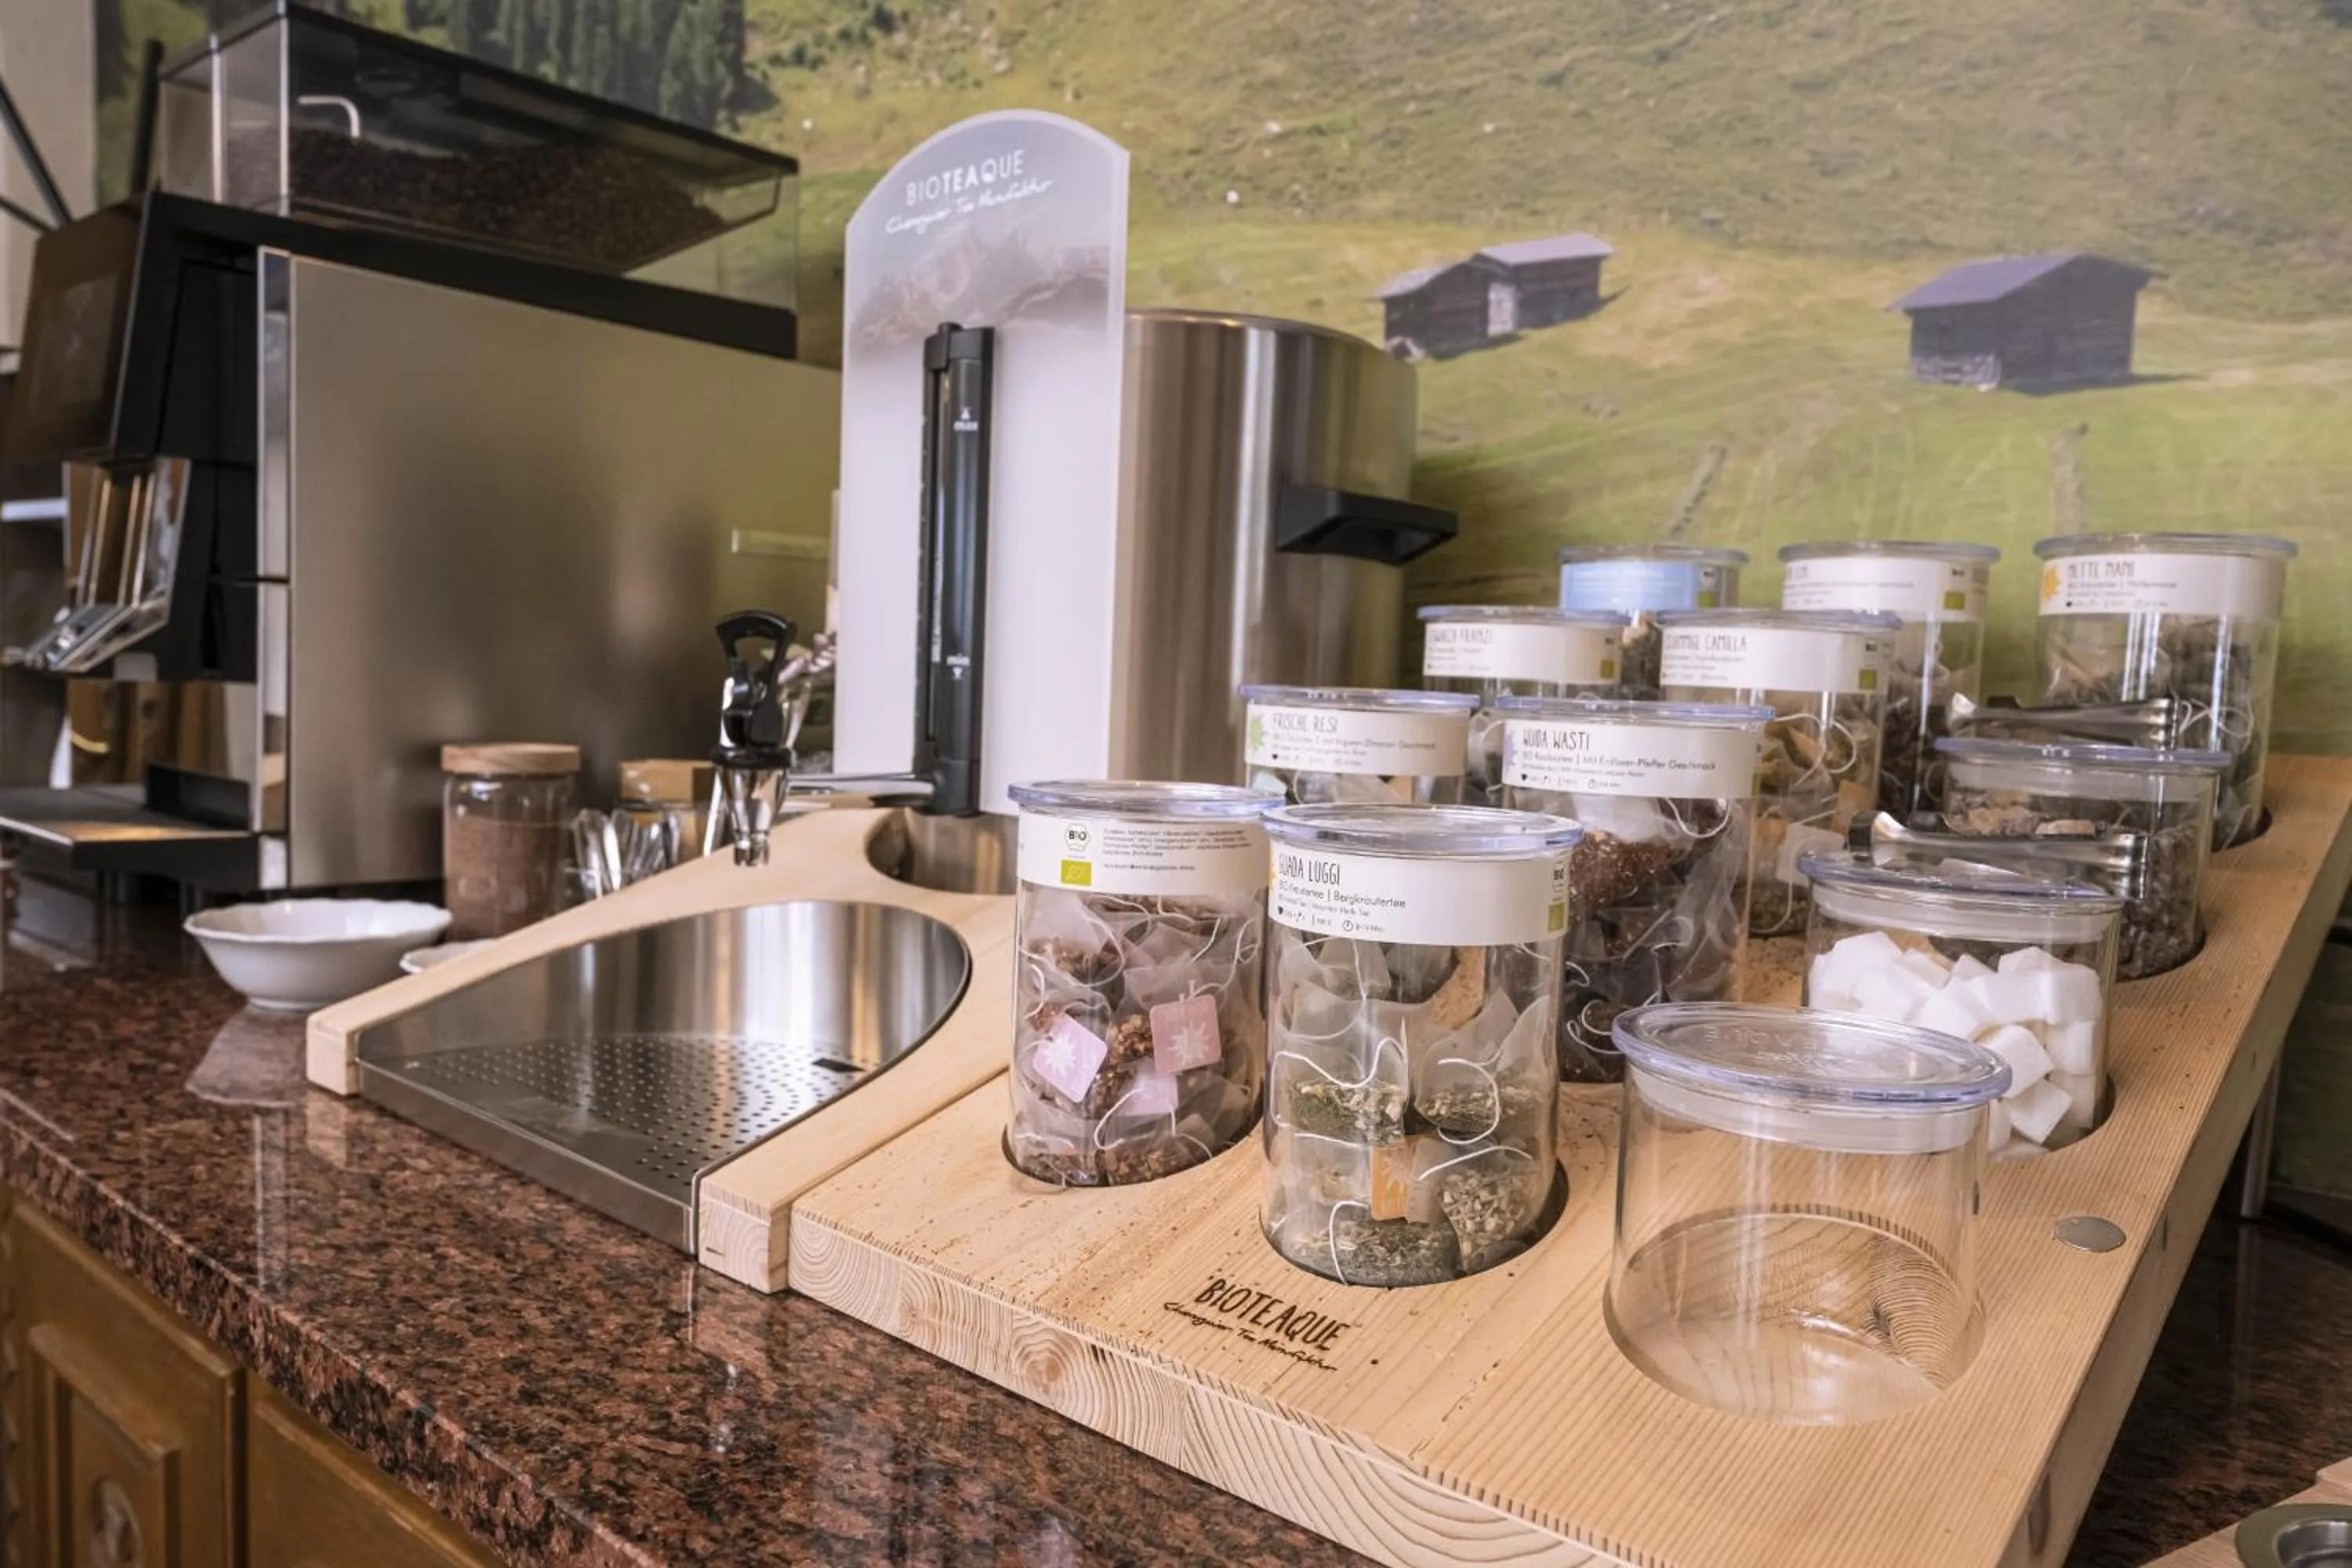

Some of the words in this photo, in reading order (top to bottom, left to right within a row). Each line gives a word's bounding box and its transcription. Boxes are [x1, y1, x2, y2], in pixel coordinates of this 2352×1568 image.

[906, 149, 1025, 206] BIOTEAQUE
[1313, 715, 1339, 734] RESI
[1553, 730, 1590, 752] WASTI
[1069, 830, 1087, 841] BIO
[1308, 859, 1340, 886] LUGGI
[1194, 1278, 1351, 1351] BIOTEAQUE
